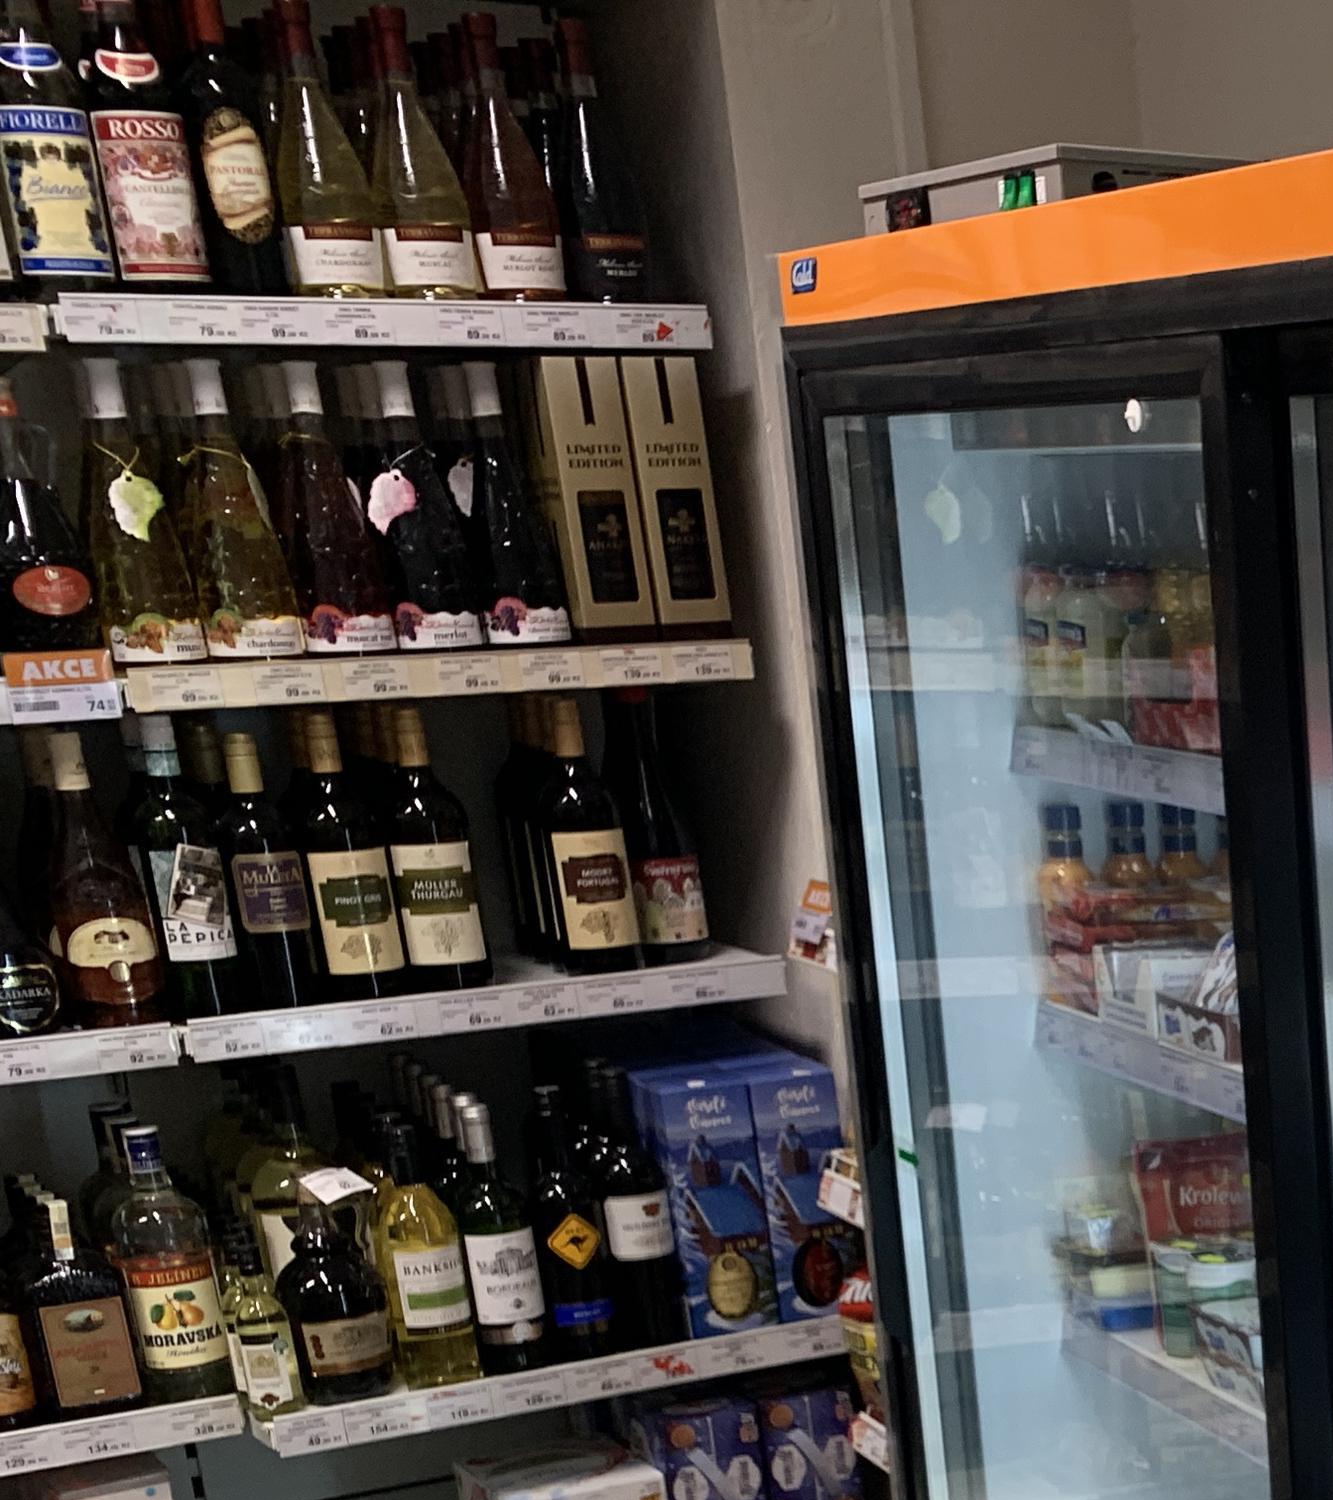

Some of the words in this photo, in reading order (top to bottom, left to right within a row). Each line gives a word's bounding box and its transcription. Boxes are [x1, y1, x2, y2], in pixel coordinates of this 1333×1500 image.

[107, 118, 180, 140] ROSSO
[566, 443, 622, 456] LIMITED
[645, 442, 701, 455] LIMITED
[568, 457, 624, 470] EDITION
[647, 456, 702, 469] EDITION
[433, 628, 469, 641] merlot
[21, 657, 97, 681] AKCE
[334, 893, 363, 907] PINOT
[410, 888, 464, 901] THURGAU
[165, 921, 188, 934] LA
[143, 1320, 223, 1349] MORAVSKÁ
